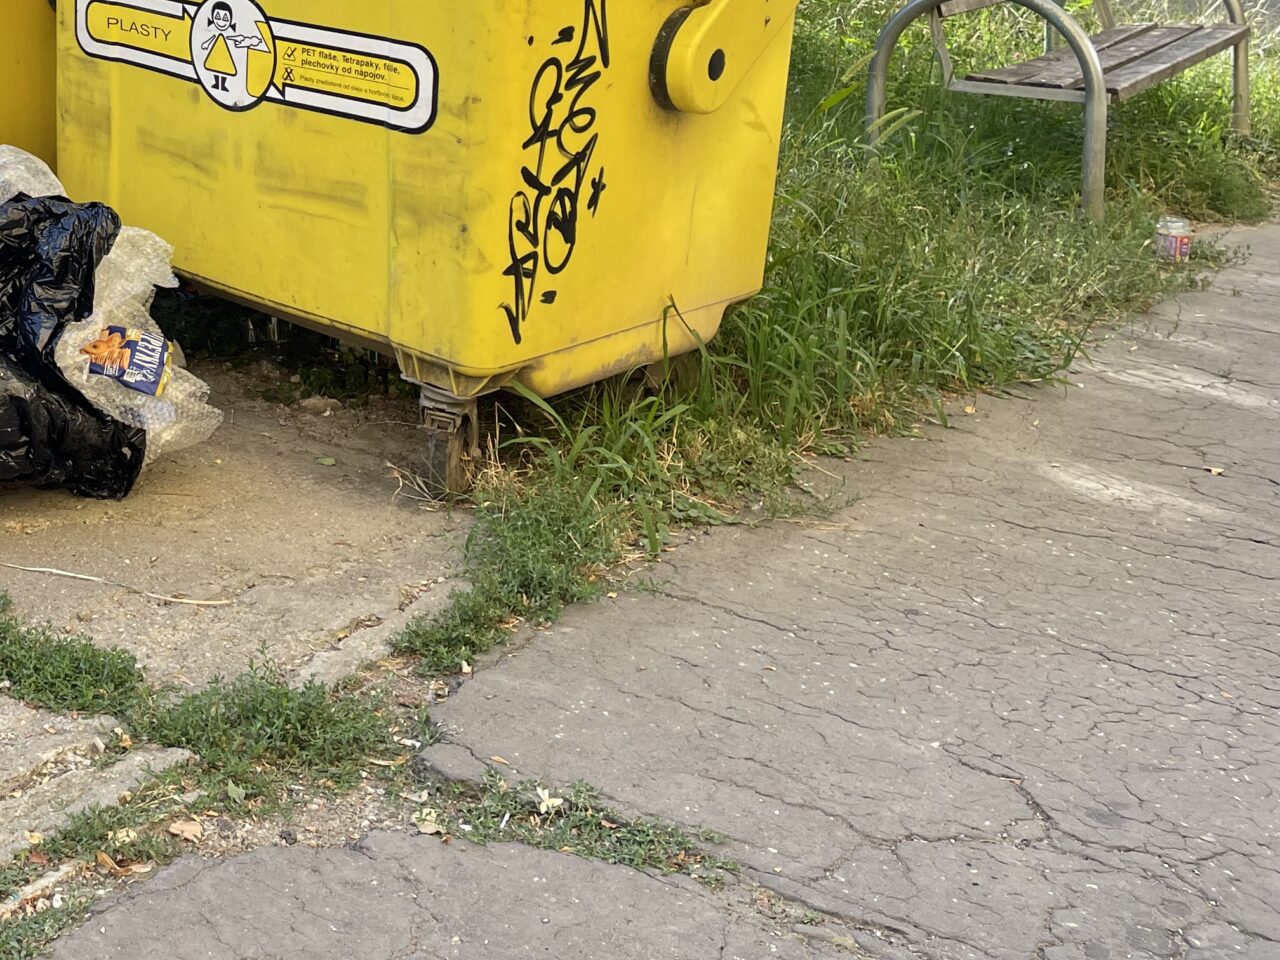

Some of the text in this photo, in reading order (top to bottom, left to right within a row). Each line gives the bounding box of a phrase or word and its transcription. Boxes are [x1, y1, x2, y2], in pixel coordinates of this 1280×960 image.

[106, 16, 172, 42] PLASTY
[301, 47, 316, 57] PET
[342, 54, 381, 71] Tetrapaky,
[301, 58, 387, 82] plechovky od nápojov.
